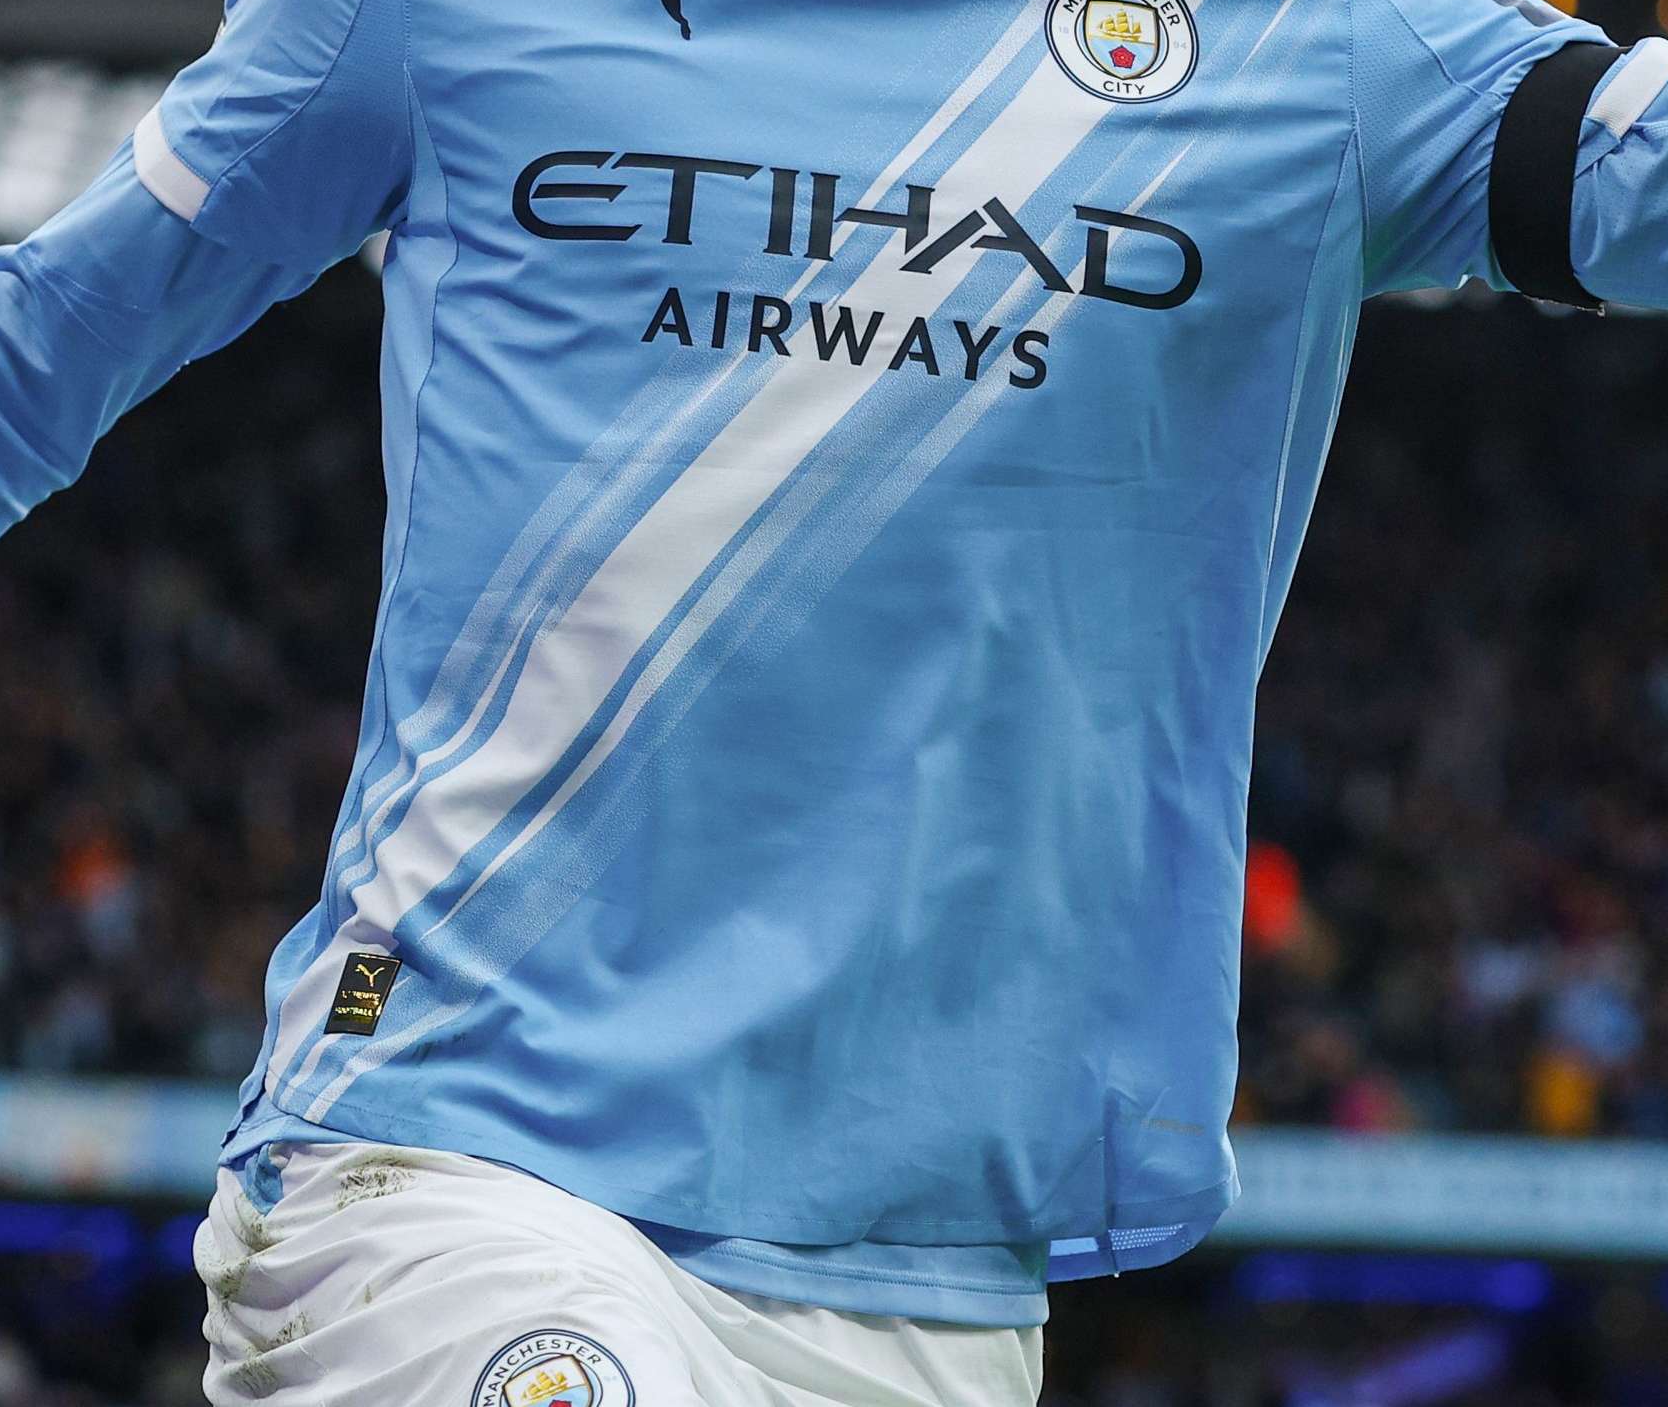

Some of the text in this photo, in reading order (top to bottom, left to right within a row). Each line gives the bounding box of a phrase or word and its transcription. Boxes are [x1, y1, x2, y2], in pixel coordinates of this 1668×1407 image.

[1103, 81, 1145, 95] CITY
[513, 151, 1203, 310] ETIHAD
[641, 286, 1051, 389] AIRWAYS
[483, 1339, 601, 1407] MANCHESTER
